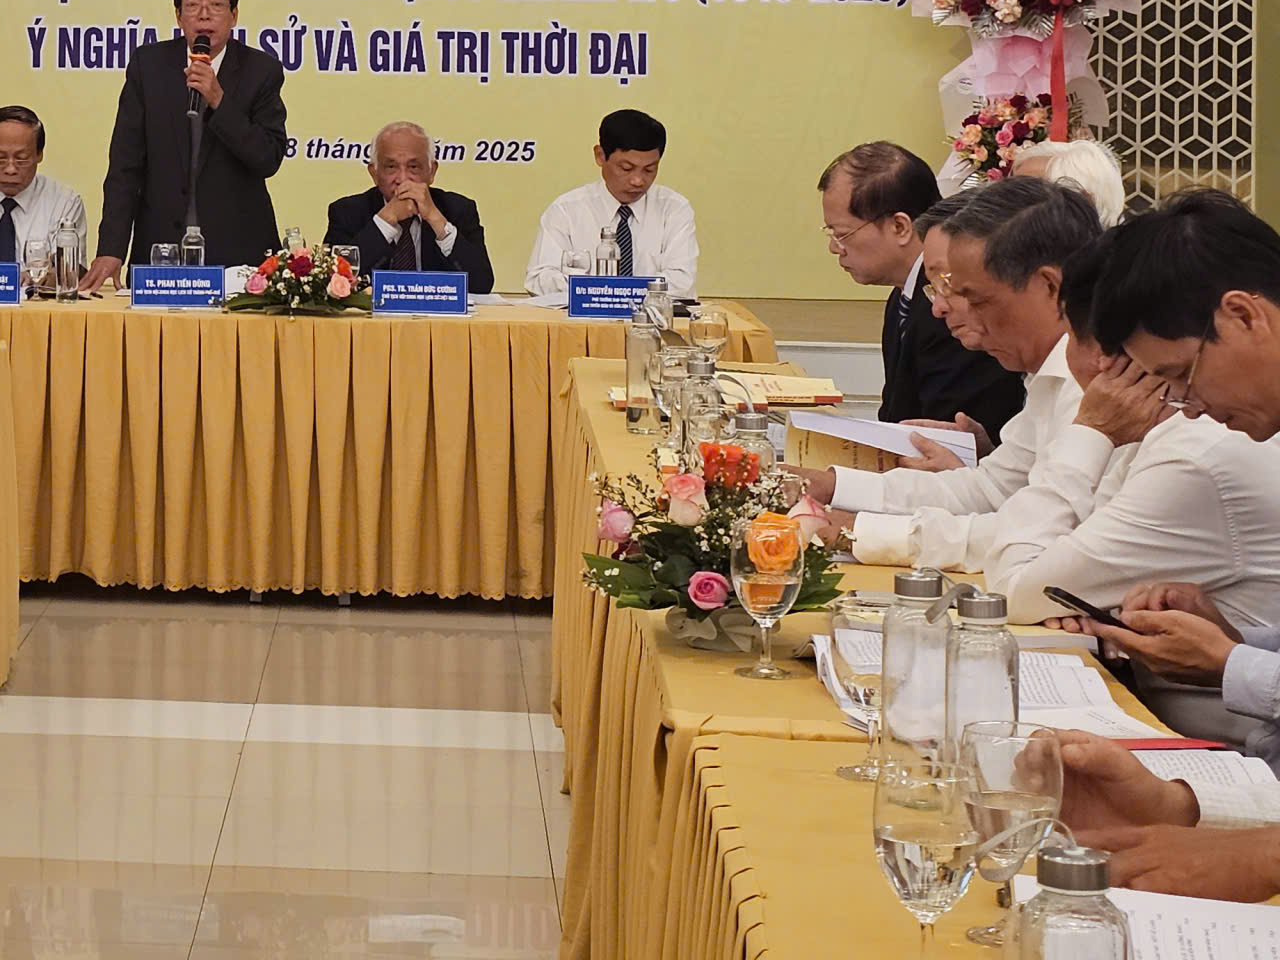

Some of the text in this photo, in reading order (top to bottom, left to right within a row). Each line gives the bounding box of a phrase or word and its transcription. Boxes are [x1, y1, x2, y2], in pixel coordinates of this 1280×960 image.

[28, 17, 46, 68] Ý
[260, 15, 306, 71] SỬ
[315, 21, 357, 71] VÀ
[370, 22, 421, 72] GIÁ
[437, 31, 489, 82] TRỊ
[502, 22, 577, 74] THỜI
[589, 33, 646, 84] ĐẠI
[283, 137, 297, 159] 8
[433, 139, 465, 161] ăm
[475, 141, 535, 161] 2025
[157, 279, 175, 287] PHAN
